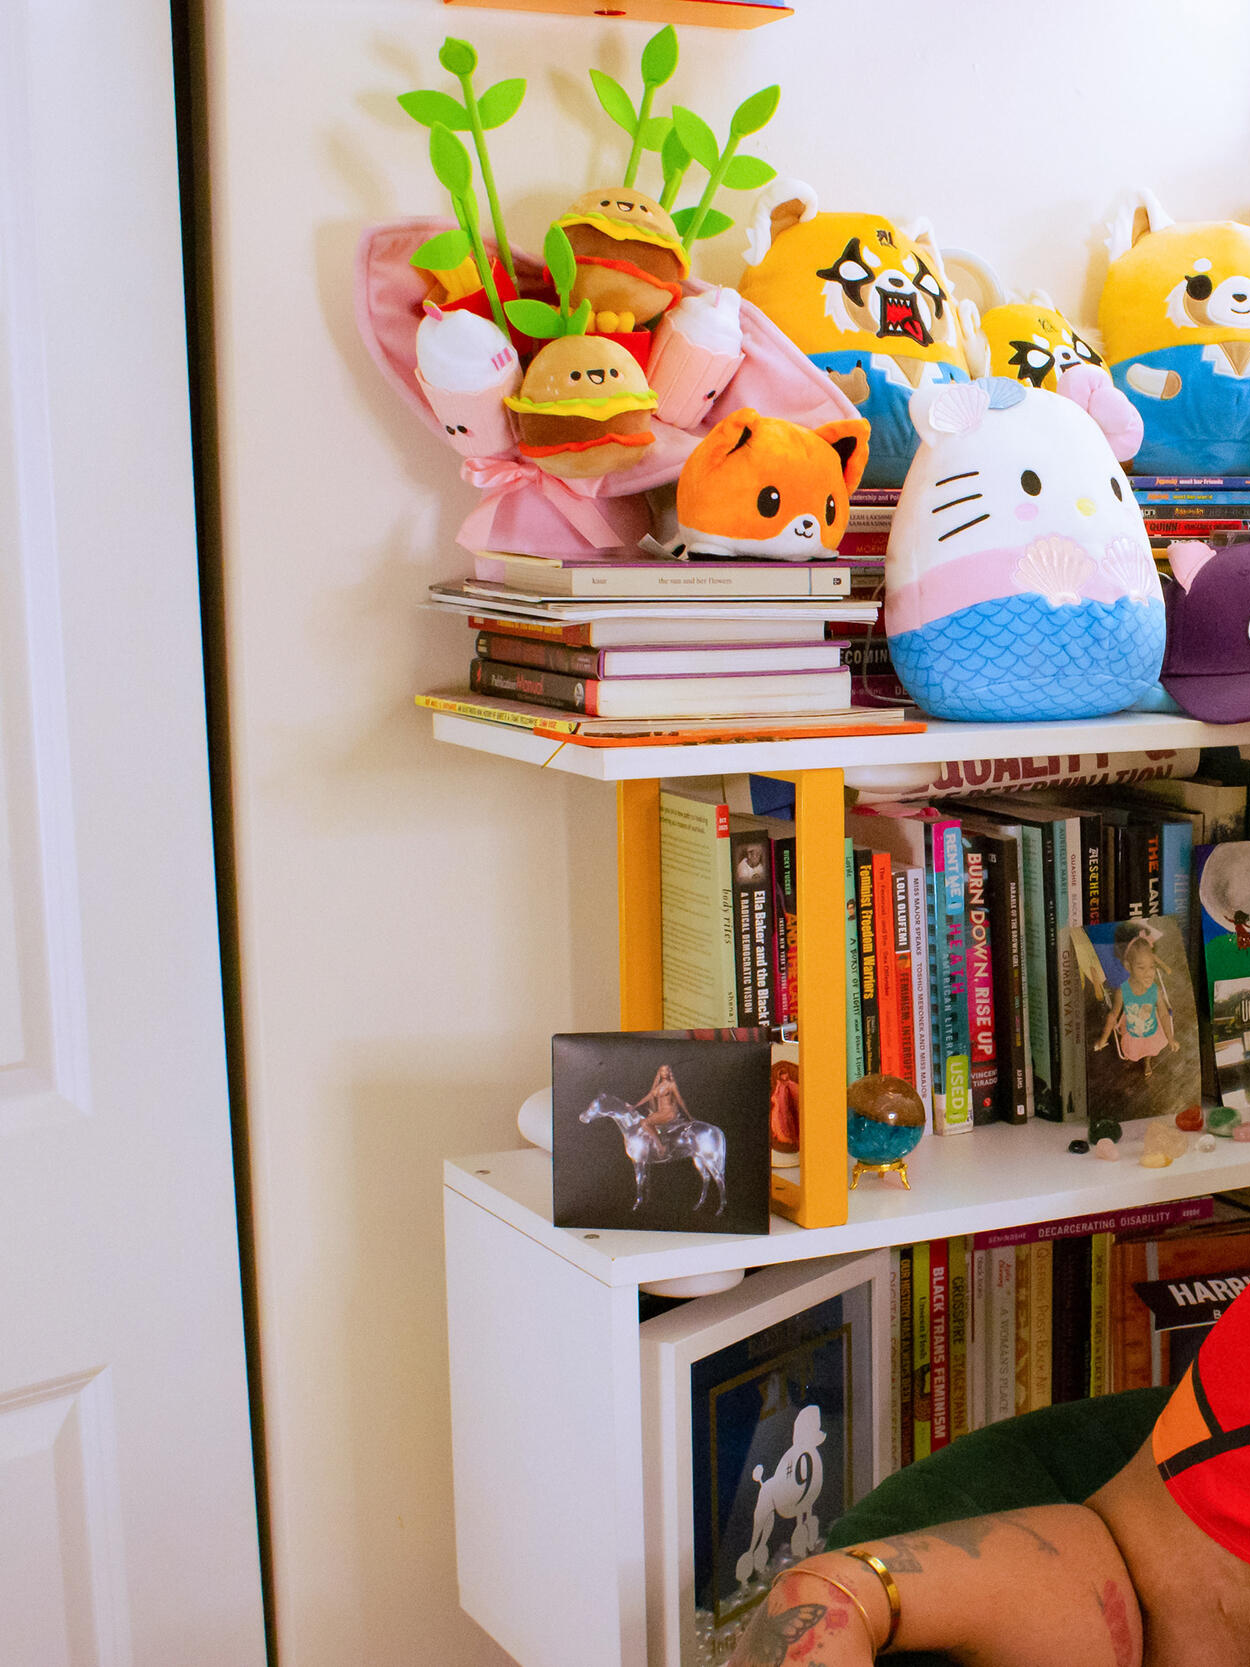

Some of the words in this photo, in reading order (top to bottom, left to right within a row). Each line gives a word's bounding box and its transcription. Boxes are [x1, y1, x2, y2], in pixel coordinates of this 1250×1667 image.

[946, 832, 958, 870] RENT
[1147, 834, 1160, 873] THE
[859, 864, 873, 907] Feminist
[895, 876, 906, 900] LOLA
[913, 877, 921, 897] MISS
[948, 872, 961, 897] ME
[967, 852, 985, 904] BURN
[721, 887, 733, 915] body
[740, 898, 750, 932] RADICAL
[754, 889, 767, 911] Ella
[913, 897, 922, 926] MAJOR
[723, 916, 733, 945] rites
[754, 912, 768, 944] Baker
[860, 909, 874, 953] Freedom
[895, 902, 908, 946] OLUFEMI
[756, 945, 769, 968] and
[914, 926, 923, 957] SPEAKS
[741, 933, 752, 985] DEMOCRATIC
[948, 923, 965, 994] HEATH
[1061, 949, 1073, 998] GUMBO
[757, 968, 769, 987] the
[852, 978, 860, 989] OF
[862, 956, 876, 1000] Warriors
[916, 962, 924, 992] TOSHIO
[743, 986, 754, 1014] VISION
[757, 988, 770, 1019] Black
[917, 993, 925, 1031] MERONEK
[974, 986, 992, 1026] RISE
[1063, 1001, 1073, 1016] YA
[918, 1031, 926, 1051] AND
[977, 1031, 993, 1056] UP
[1063, 1019, 1073, 1037] YA
[919, 1051, 927, 1071] MISS
[920, 1071, 928, 1099] MAJOR
[949, 1060, 965, 1109] USED
[973, 1078, 998, 1087] TIRADO
[1037, 1218, 1116, 1239] DECARCERATING
[1119, 1211, 1171, 1226] DISABILITY
[901, 1258, 910, 1279] OUR
[901, 1279, 911, 1318] HISTORY
[932, 1266, 945, 1313] BLACK
[919, 1295, 928, 1333] Unseen
[952, 1275, 965, 1345] CROSSFIRE
[919, 1333, 928, 1360] Flesh
[933, 1315, 945, 1364] TRANS
[933, 1366, 946, 1440] FEMINISM
